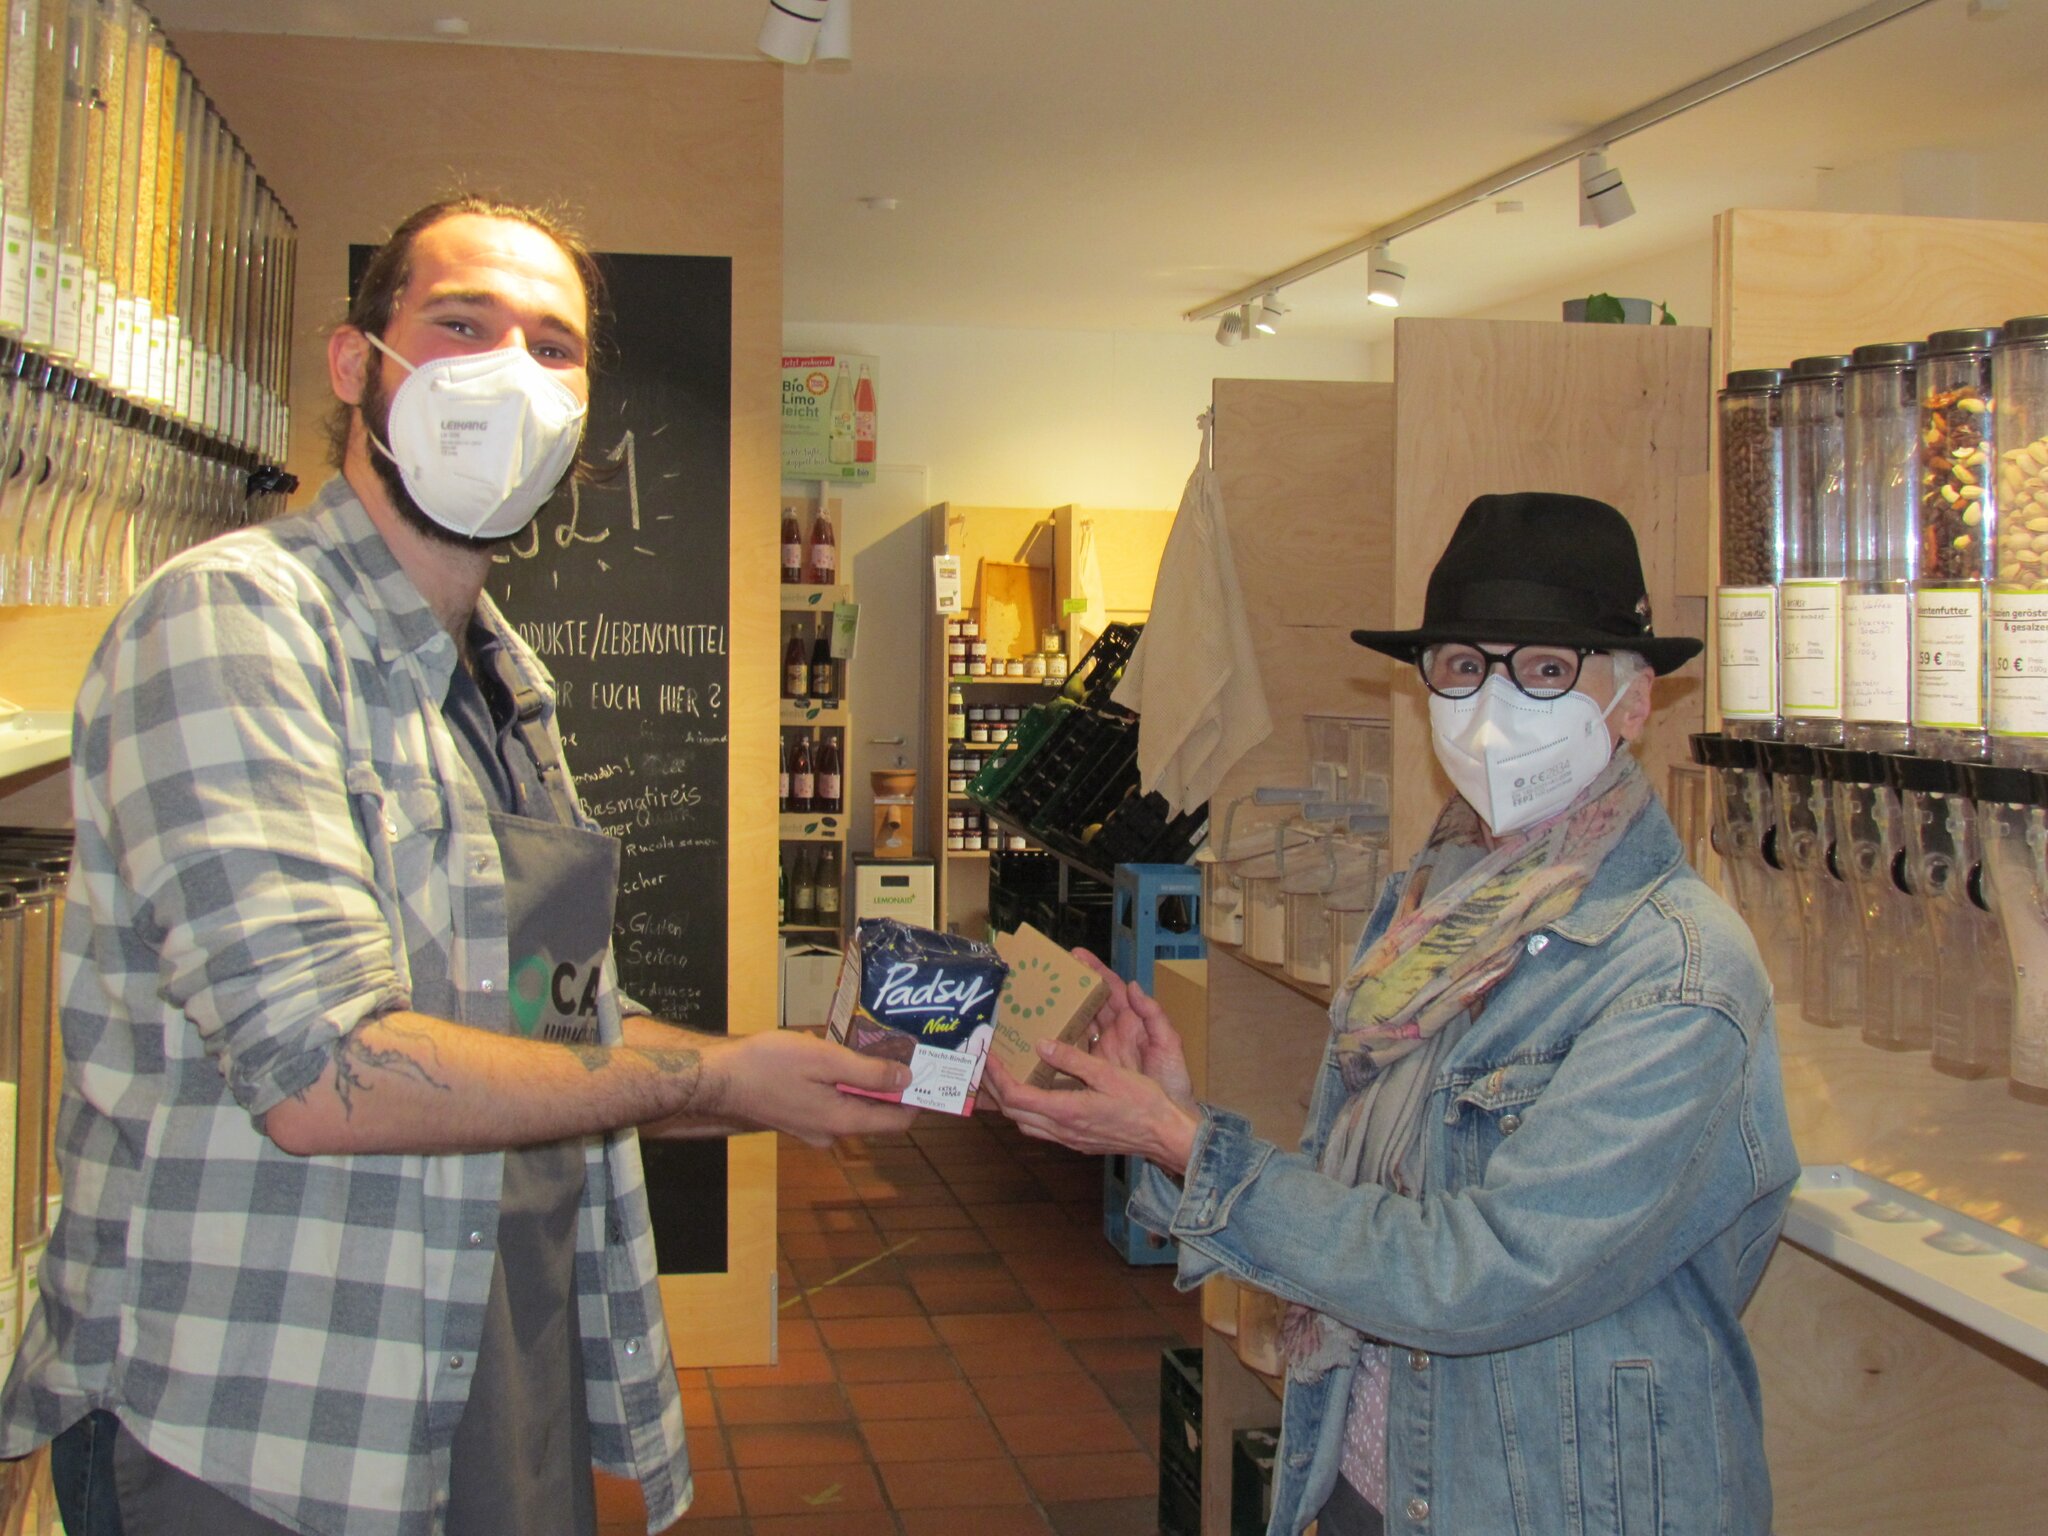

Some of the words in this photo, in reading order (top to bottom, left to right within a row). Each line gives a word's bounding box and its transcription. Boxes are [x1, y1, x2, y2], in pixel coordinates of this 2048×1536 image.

[781, 394, 816, 405] Limo
[781, 406, 819, 418] leicht
[1934, 652, 1943, 665] €
[2014, 658, 2023, 671] €
[591, 682, 641, 710] EUCH
[660, 684, 700, 718] HIER
[873, 962, 994, 1015] Padsy
[922, 1015, 961, 1035] Nuit
